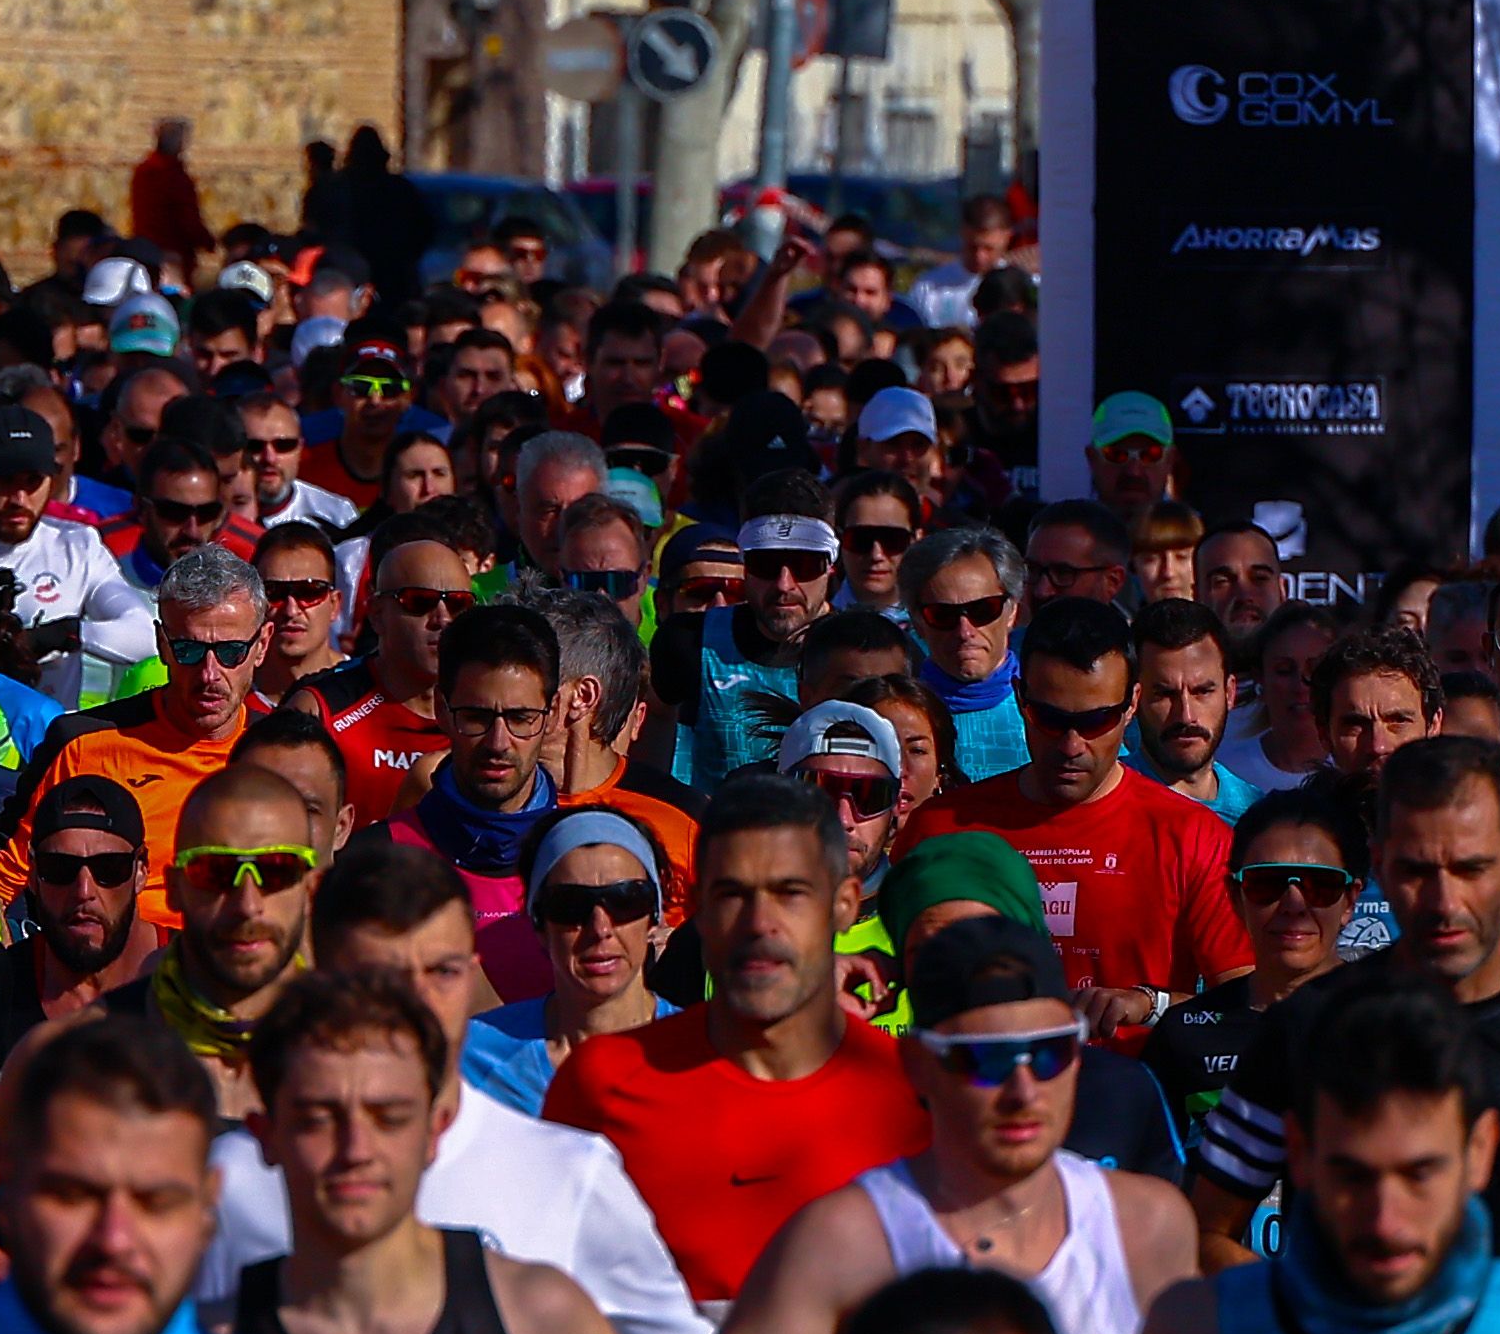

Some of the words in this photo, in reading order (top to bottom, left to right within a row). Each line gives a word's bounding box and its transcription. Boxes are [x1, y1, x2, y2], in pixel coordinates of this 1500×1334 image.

[1237, 72, 1339, 99] COX
[1237, 98, 1395, 127] GOMYL
[1225, 382, 1381, 421] TECNOCASA
[332, 692, 385, 734] RUNNERS
[1025, 848, 1056, 857] CARRERA
[1057, 848, 1091, 856] POPULAR
[1053, 857, 1067, 865] DEL
[1068, 857, 1094, 865] CAMPO
